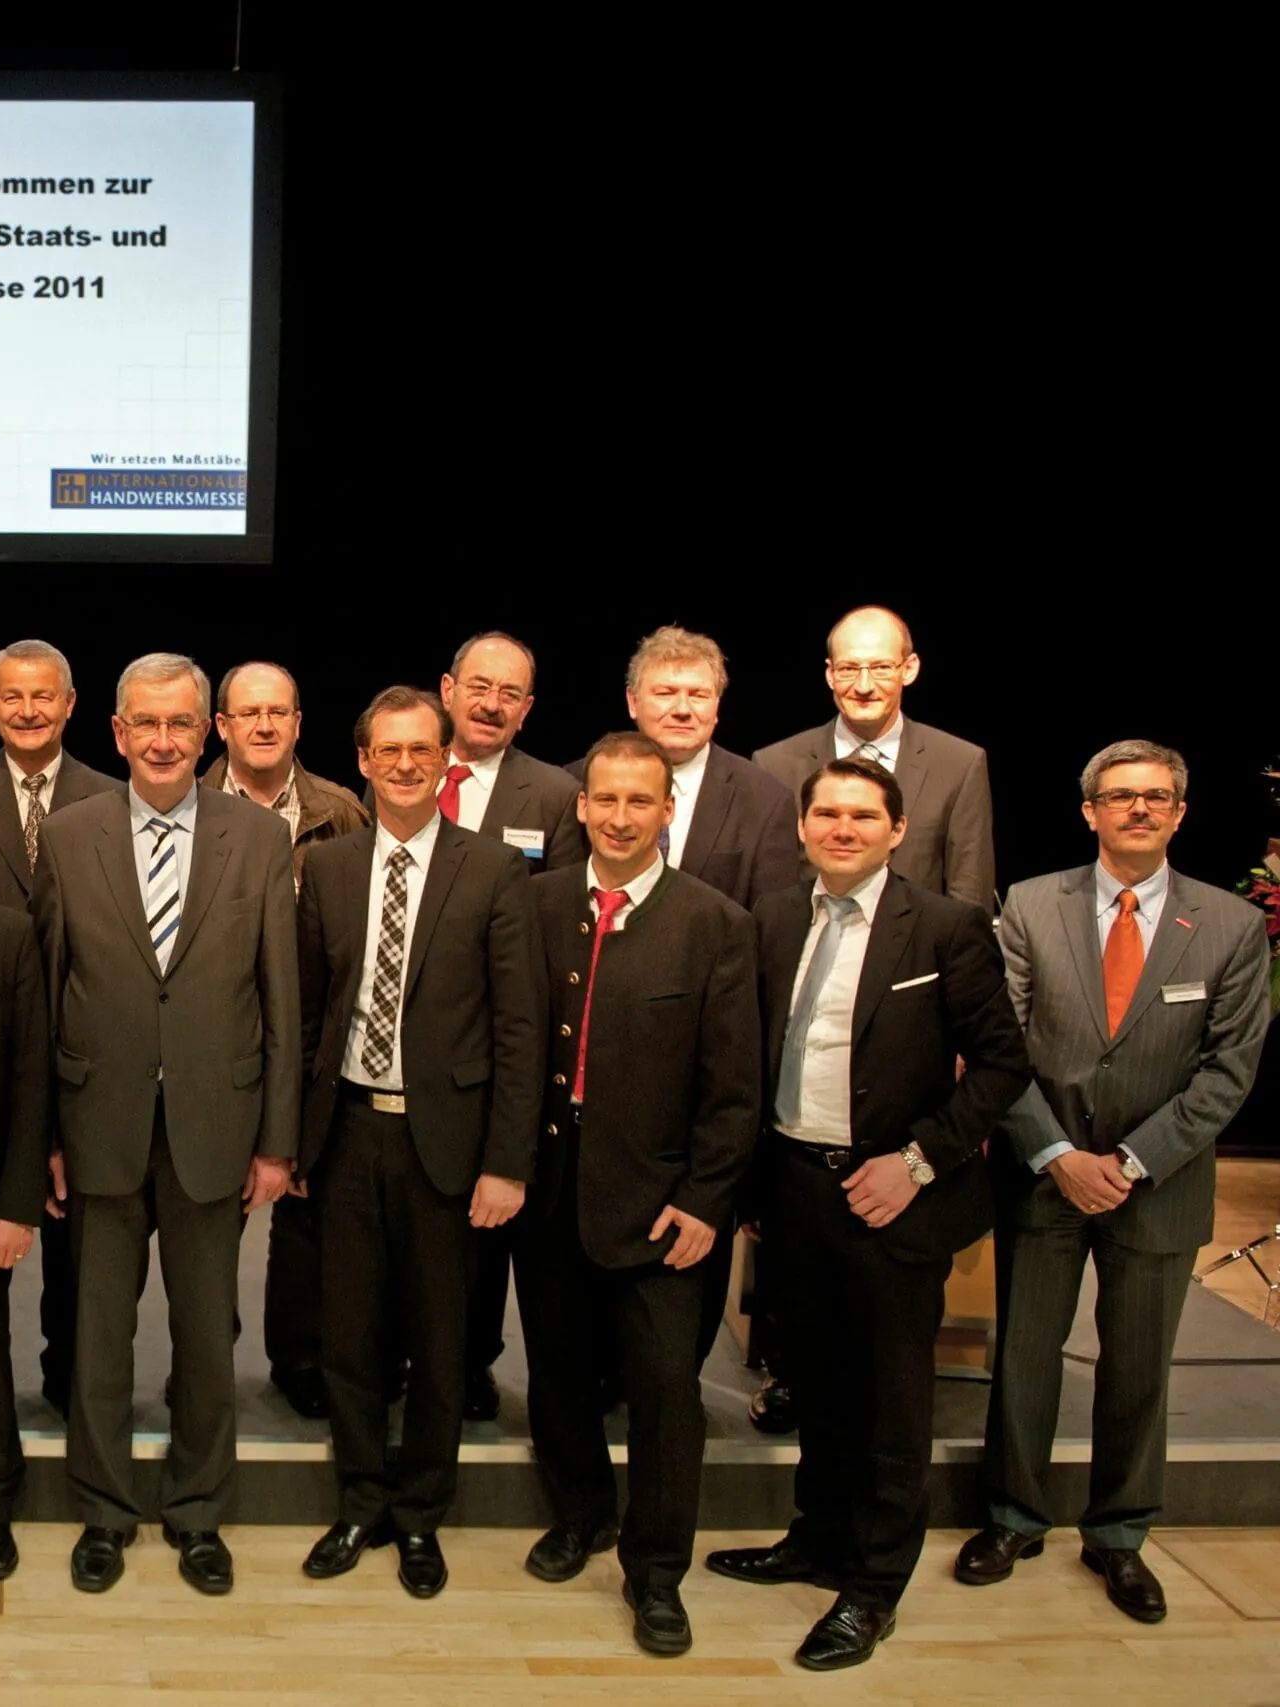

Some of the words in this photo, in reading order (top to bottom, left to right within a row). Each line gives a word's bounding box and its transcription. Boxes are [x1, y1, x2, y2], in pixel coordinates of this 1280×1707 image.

[104, 177, 153, 195] zur
[111, 224, 168, 248] und
[33, 275, 105, 299] 2011
[90, 453, 116, 465] Wir
[121, 453, 167, 465] setzen
[90, 473, 246, 489] INTERNATIONALE
[90, 490, 246, 507] HANDWERKSMESSE
